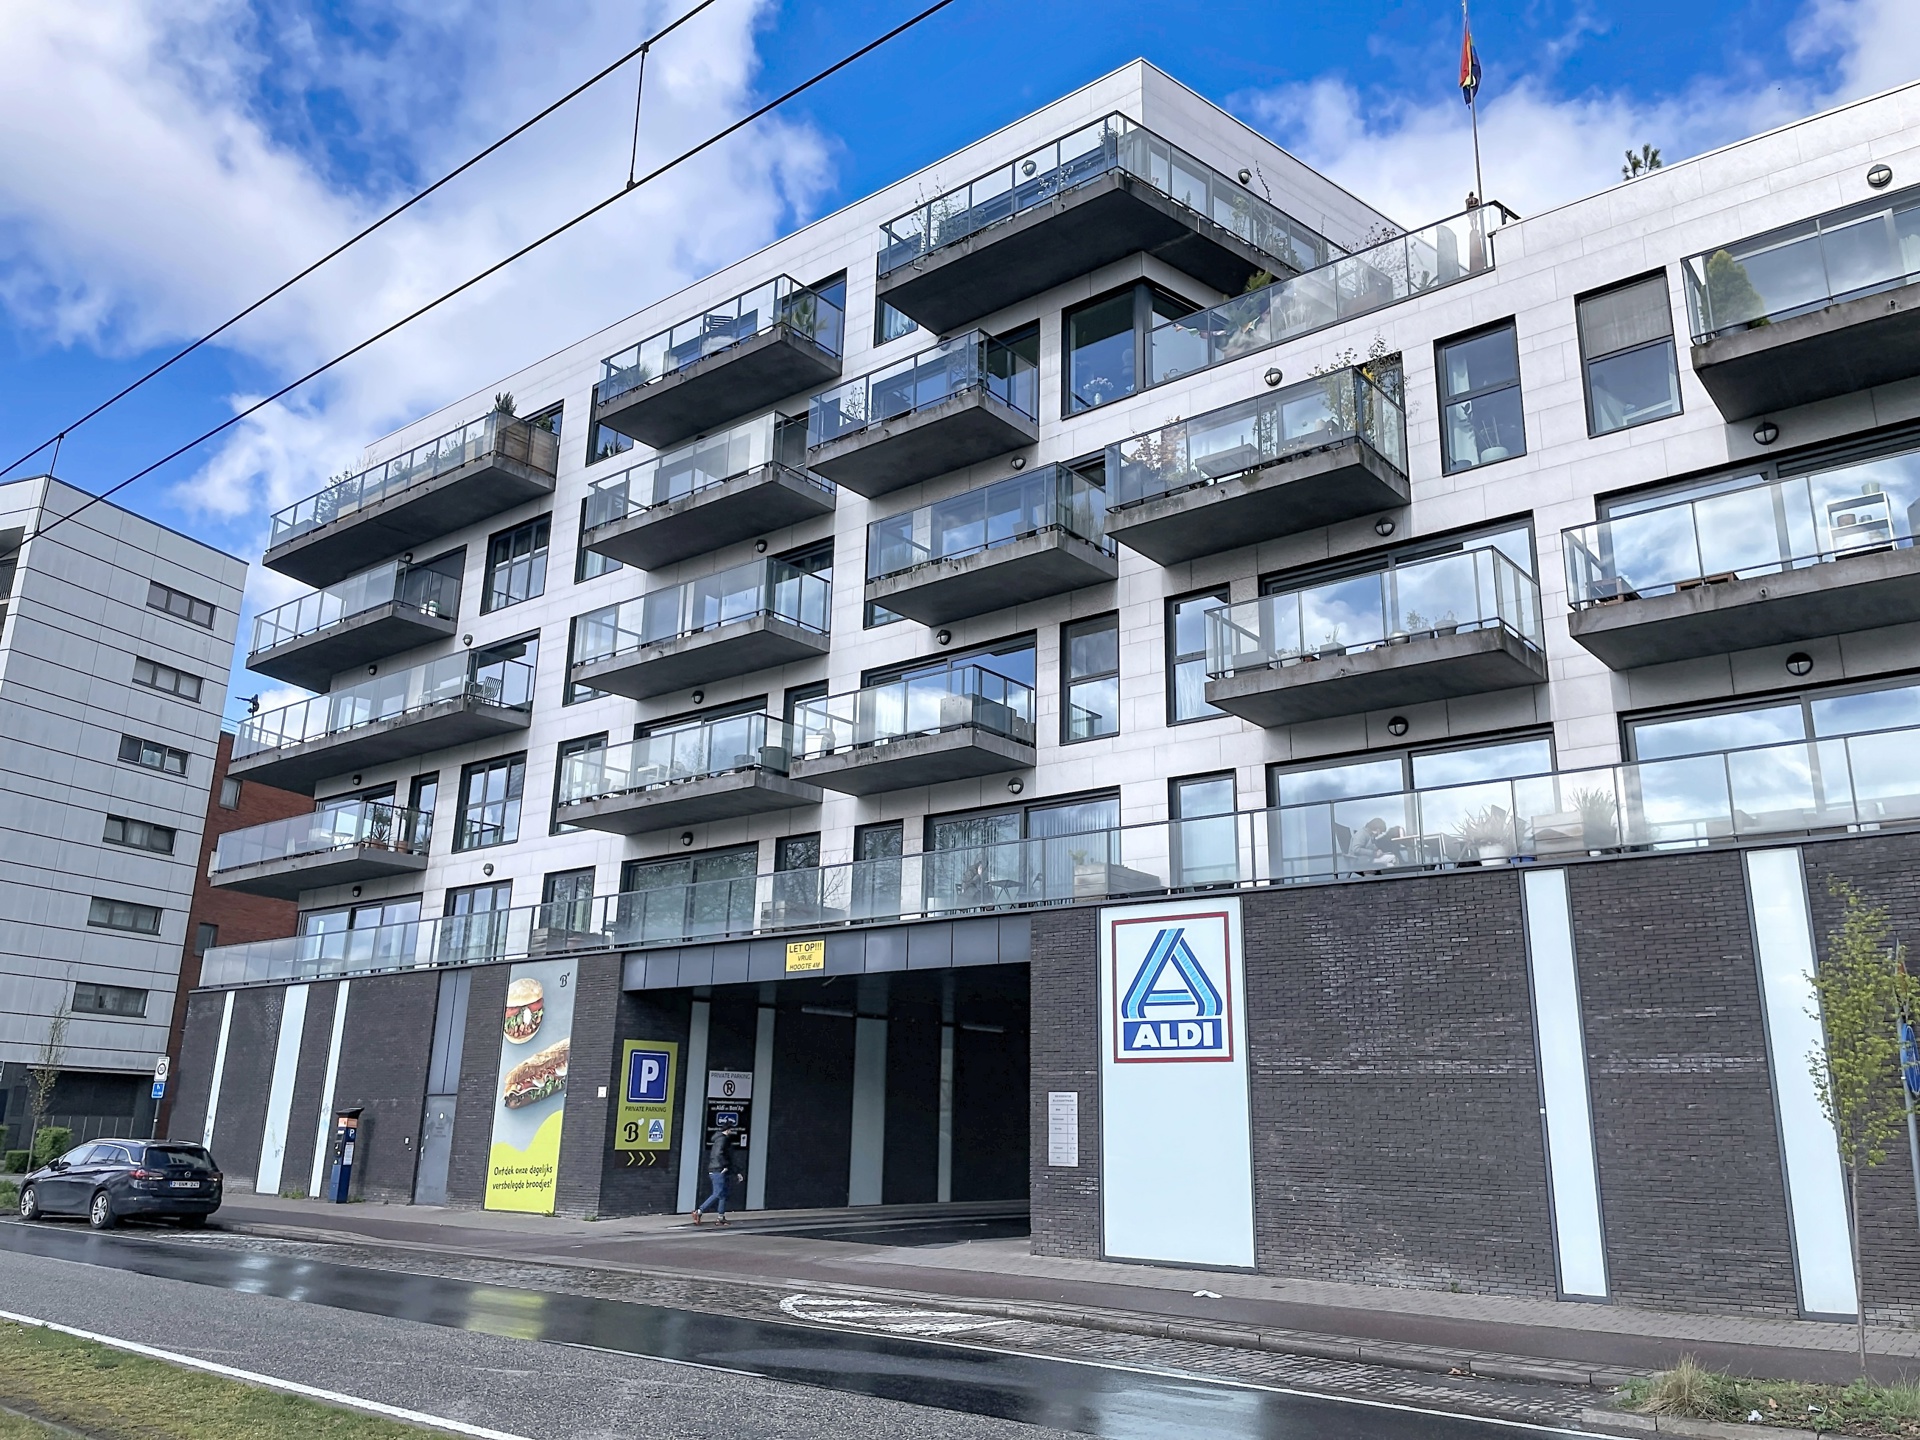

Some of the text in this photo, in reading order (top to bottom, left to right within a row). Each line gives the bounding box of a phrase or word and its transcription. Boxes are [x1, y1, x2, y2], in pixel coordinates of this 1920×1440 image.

[789, 942, 822, 953] LET OP!!!
[1131, 1021, 1214, 1048] ALDI
[640, 1059, 659, 1093] P
[494, 1165, 514, 1175] Ontdek
[529, 1163, 553, 1177] dagelijks
[492, 1178, 553, 1192] versbelegde broodjes!
